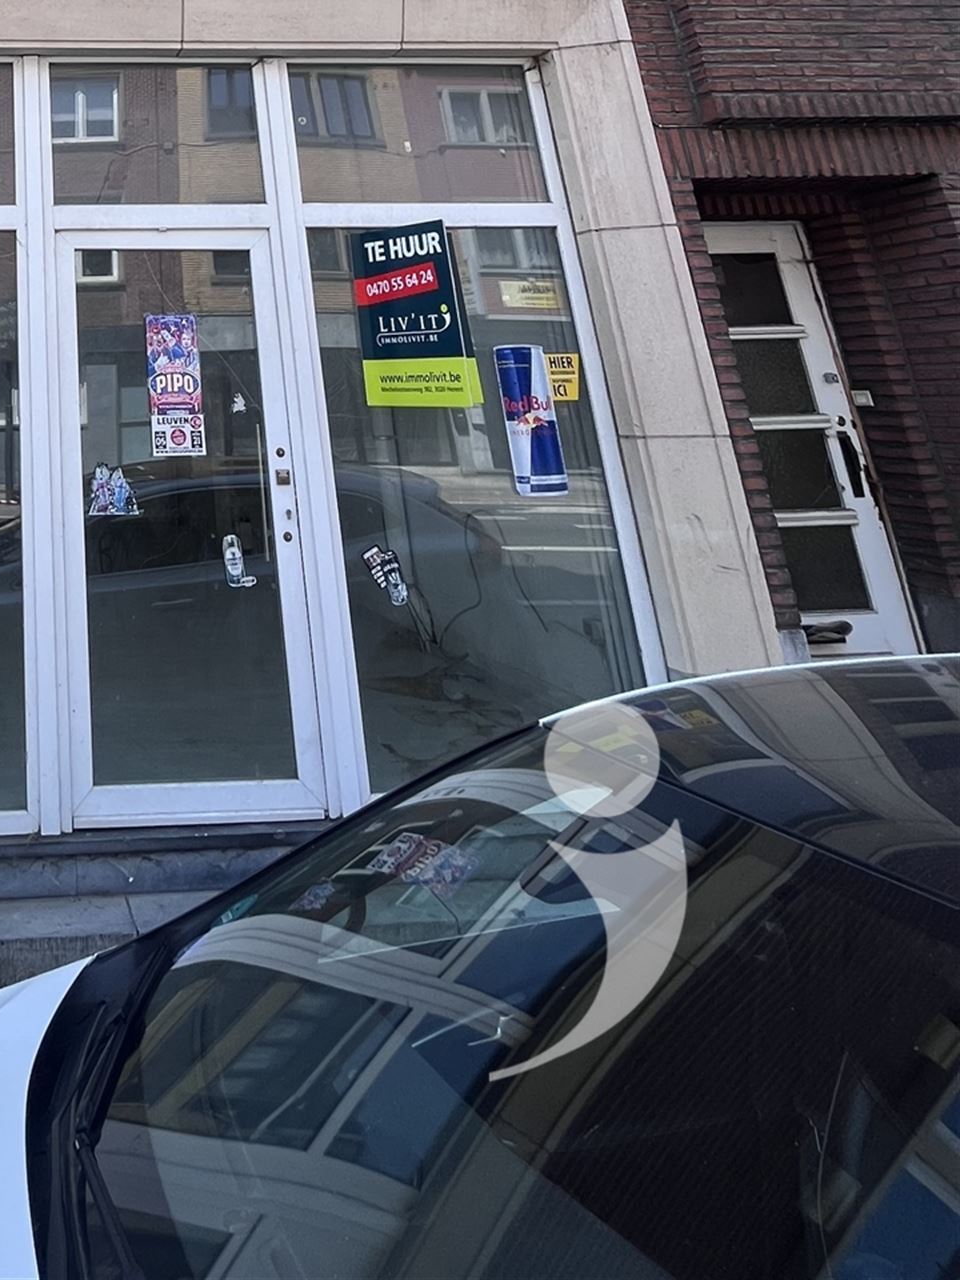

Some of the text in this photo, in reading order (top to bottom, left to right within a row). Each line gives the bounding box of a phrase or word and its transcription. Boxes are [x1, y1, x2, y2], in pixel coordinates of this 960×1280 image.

[364, 231, 442, 263] TE HUUR
[366, 269, 434, 297] 0470 55 64 24
[548, 356, 575, 369] HIER
[155, 373, 195, 395] PIPO
[379, 372, 462, 383] www.immolivit.be
[552, 384, 568, 397] ICI
[503, 395, 529, 412] Red
[156, 417, 190, 426] LEUVEN
